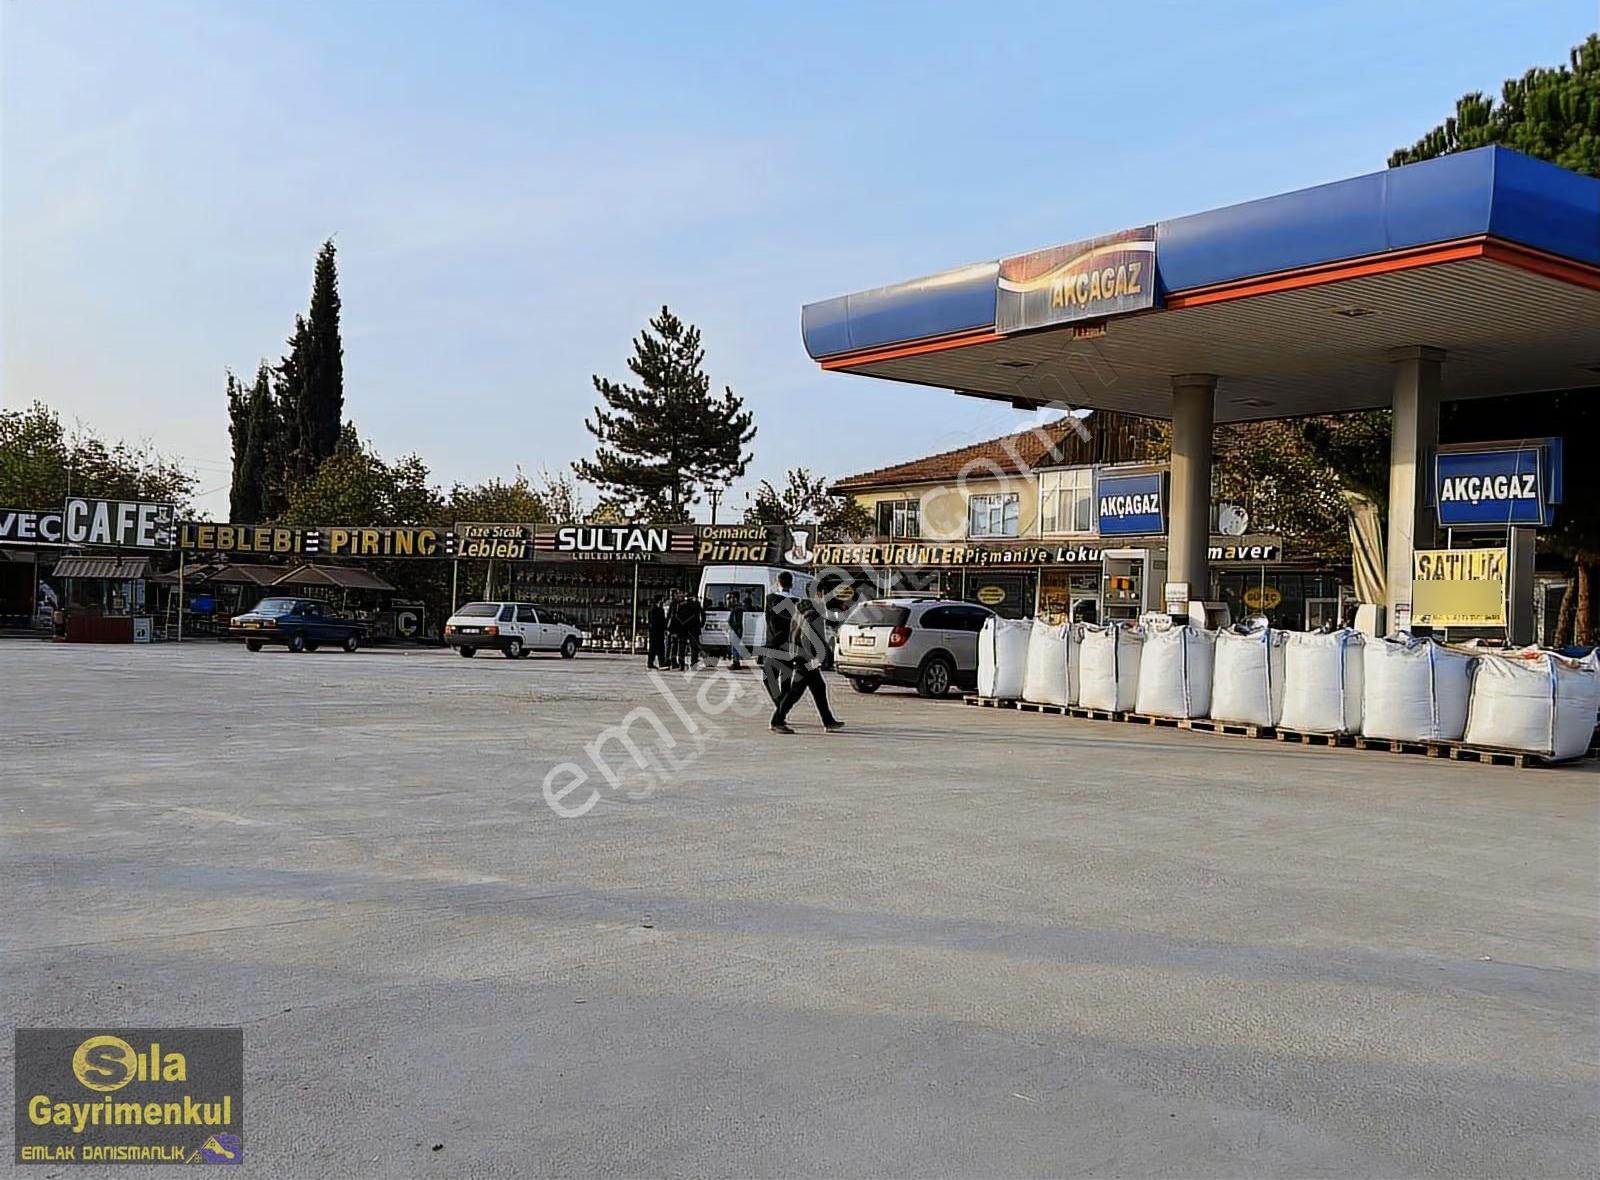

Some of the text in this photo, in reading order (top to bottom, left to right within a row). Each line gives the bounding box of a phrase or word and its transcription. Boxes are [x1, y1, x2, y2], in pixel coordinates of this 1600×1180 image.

[1052, 261, 1142, 309] AKÇAGAZ
[1440, 474, 1536, 504] AKÇAGAZ
[1100, 493, 1159, 519] AKÇAGAZ
[66, 499, 158, 546] CAFE
[464, 526, 490, 537] Taze
[703, 526, 768, 539] Osmancık
[458, 539, 527, 558] Leblebi
[559, 528, 668, 552] SULTAN
[698, 541, 768, 561] Pirinci
[1056, 546, 1104, 562] Loku
[1207, 545, 1273, 560] maver
